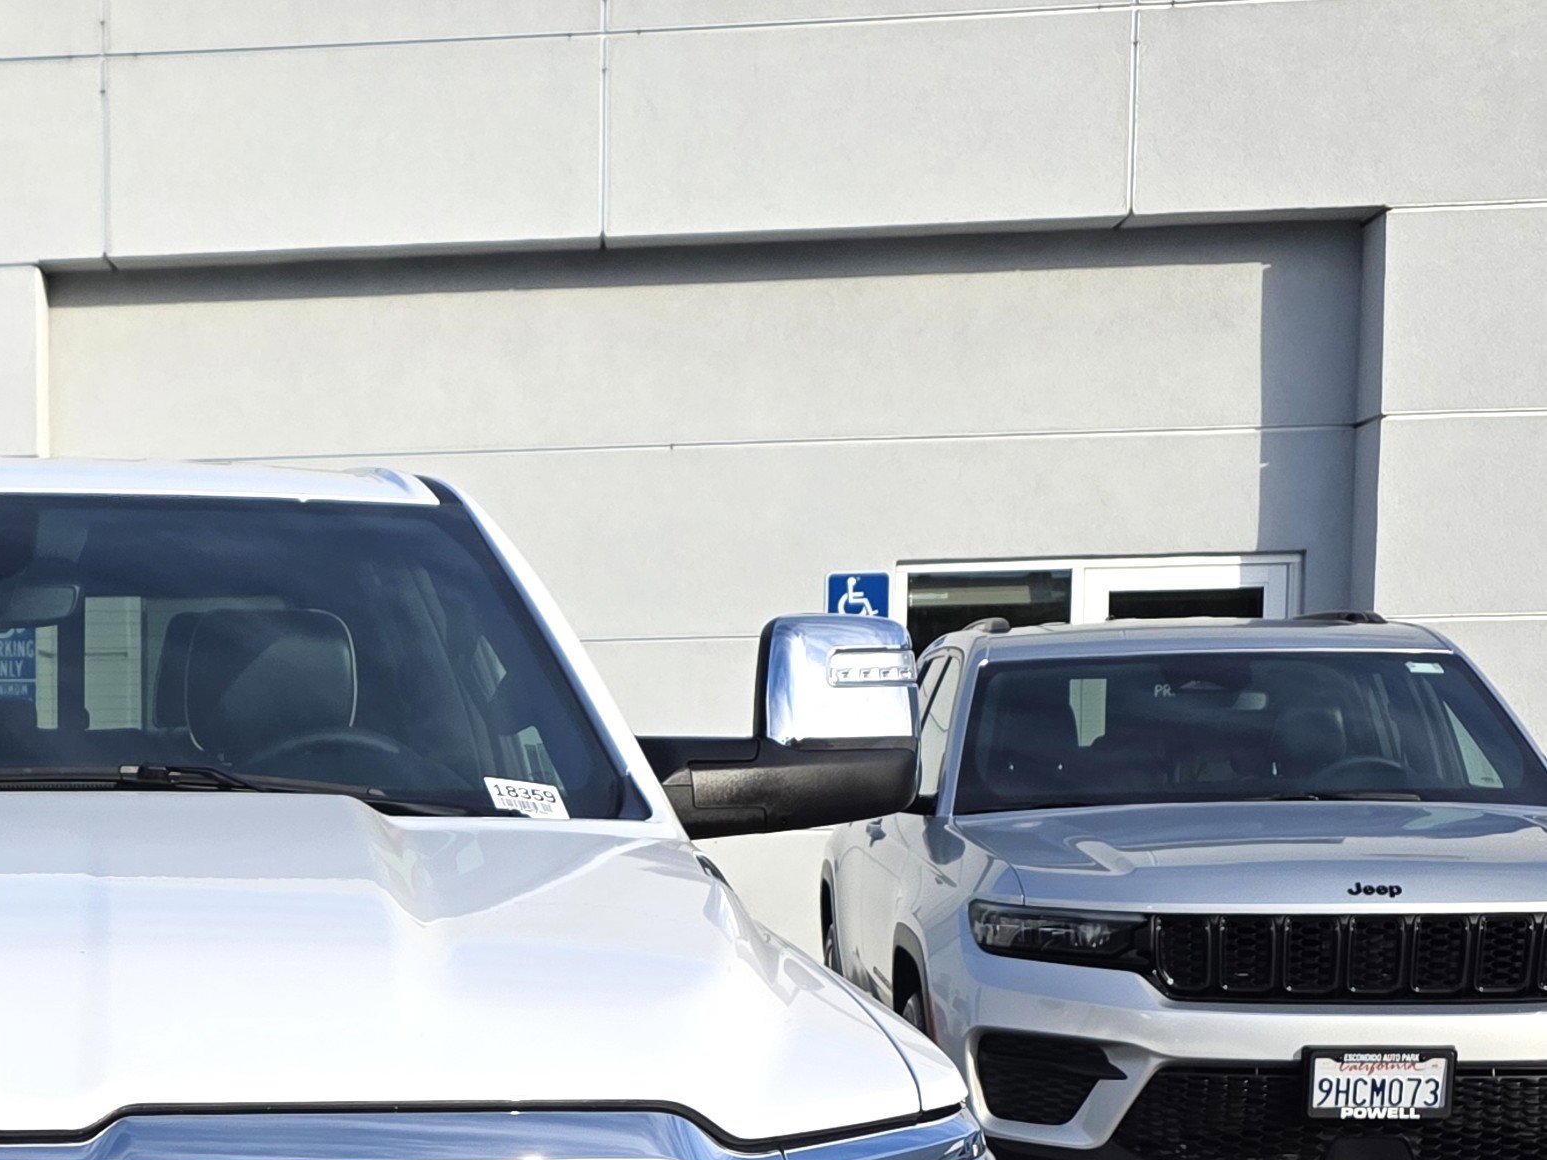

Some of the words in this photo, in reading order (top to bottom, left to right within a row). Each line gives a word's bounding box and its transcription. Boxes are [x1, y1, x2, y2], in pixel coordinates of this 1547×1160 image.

[493, 783, 557, 804] 18359
[1347, 881, 1403, 899] Jeep
[1343, 1053, 1382, 1062] ESCONDIDO
[1383, 1053, 1401, 1062] AUTO
[1401, 1053, 1420, 1062] PARK
[1316, 1077, 1440, 1107] 9HCM073
[1340, 1107, 1420, 1119] POWELL
